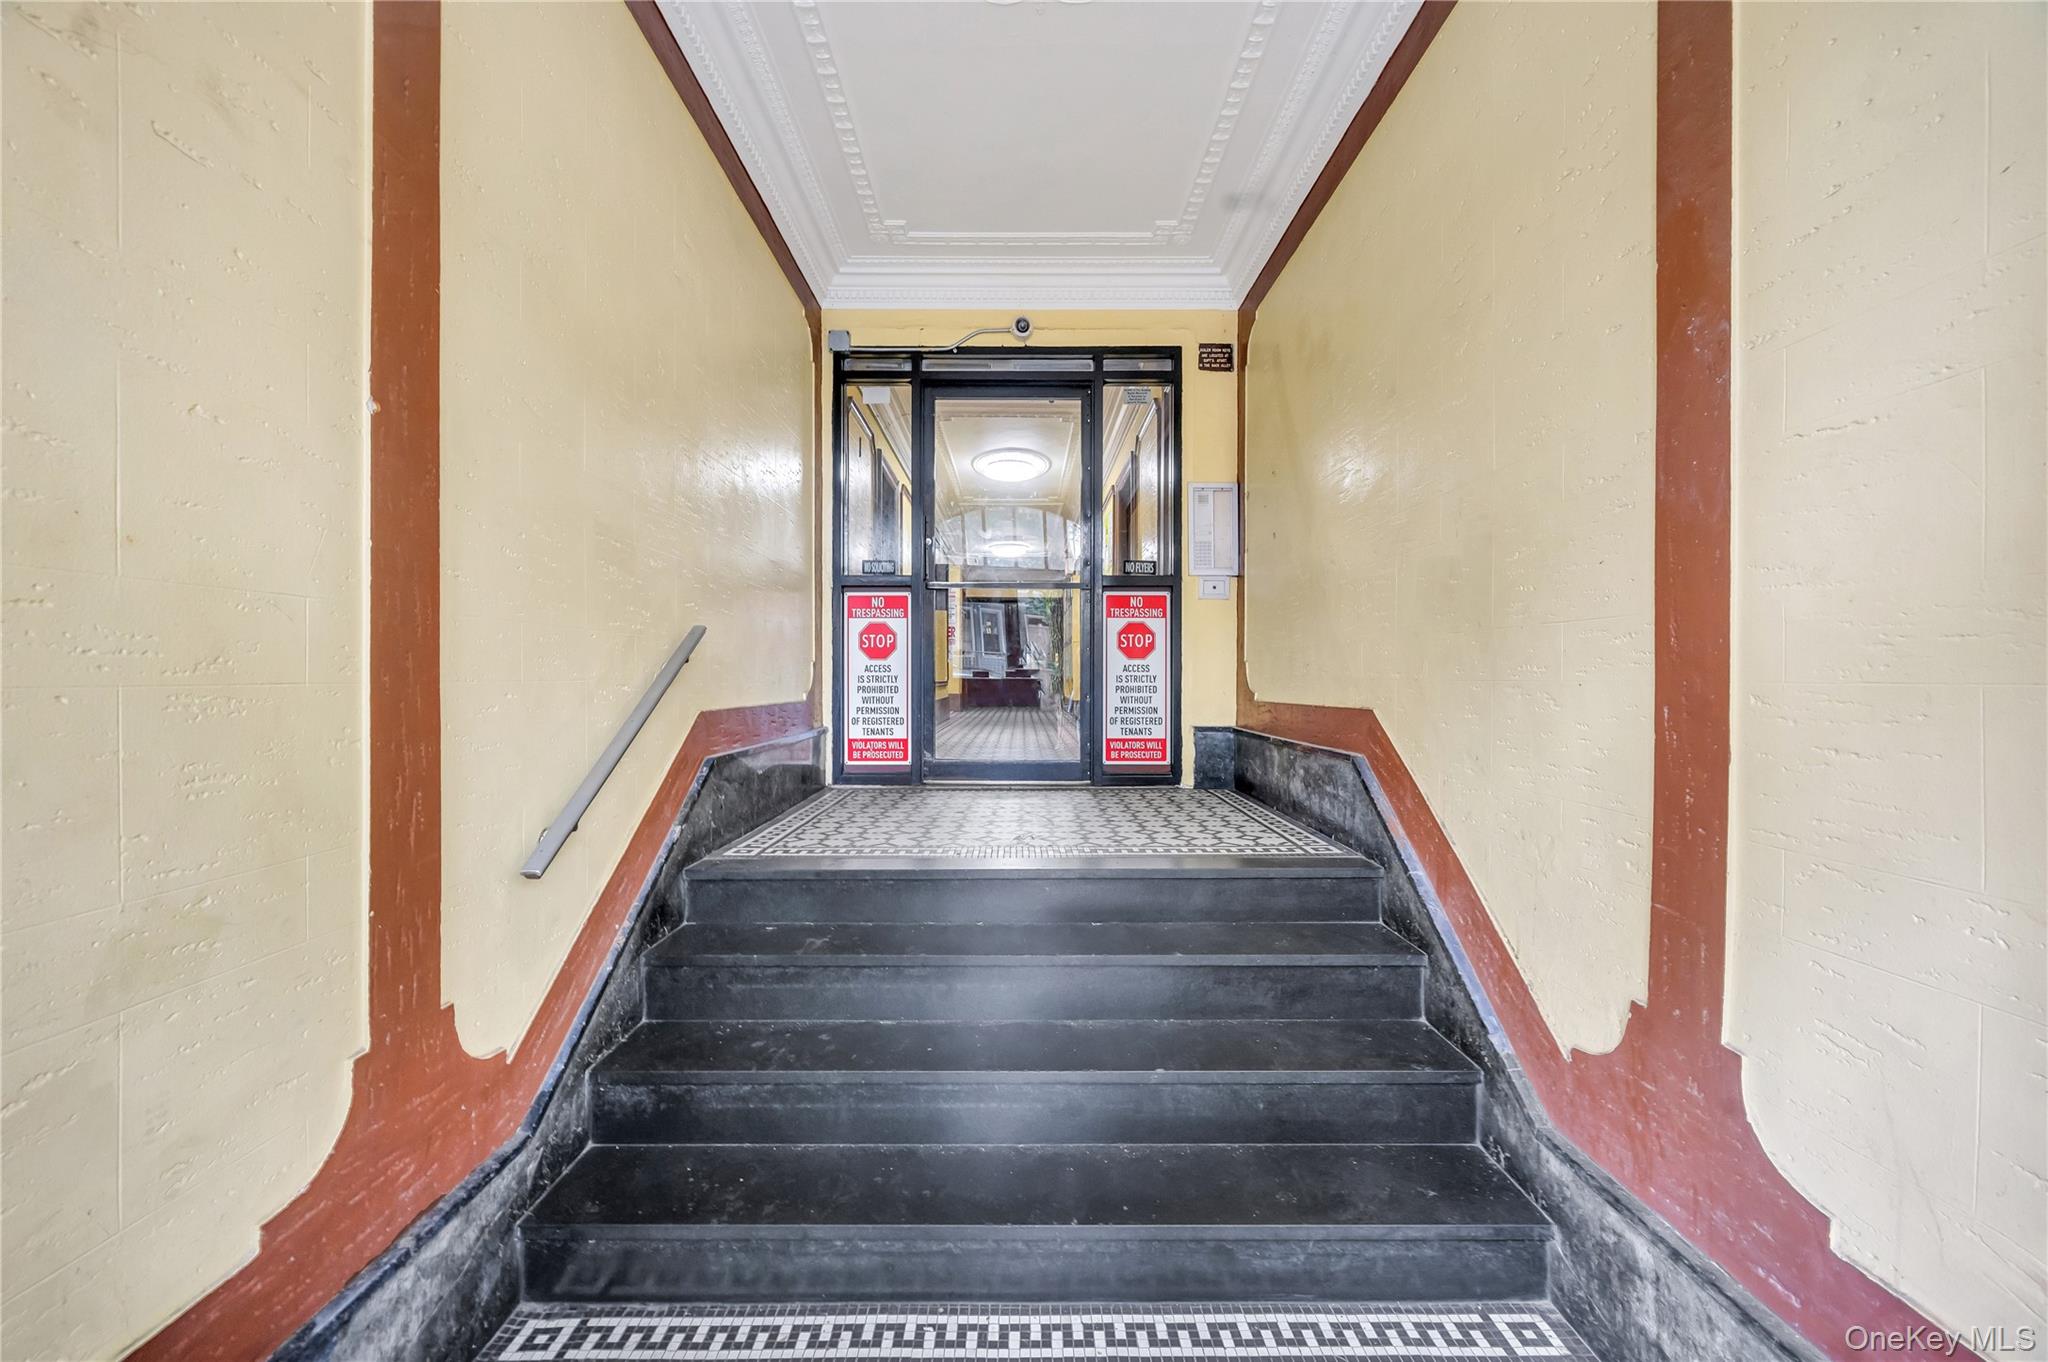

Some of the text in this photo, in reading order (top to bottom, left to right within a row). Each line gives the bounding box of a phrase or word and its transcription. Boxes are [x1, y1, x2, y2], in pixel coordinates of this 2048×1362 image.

[1125, 561, 1155, 574] NO FLYERS
[871, 596, 885, 608] NO
[1129, 596, 1143, 608] NO
[852, 608, 905, 618] TRESPASSING
[1110, 608, 1163, 618] TRESPASSING
[862, 634, 894, 648] STOP
[1120, 634, 1152, 648] STOP
[864, 664, 892, 673] ACCESS
[1122, 664, 1150, 673] ACCESS
[857, 675, 899, 684] IS STRICTLY
[1115, 675, 1157, 684] IS STRICTLY
[857, 685, 899, 694] PROHIBITED
[1115, 685, 1157, 694] PROHIBITED
[861, 696, 894, 705] WITHOUT
[1119, 696, 1152, 705] WITHOUT
[856, 706, 900, 715] PERMISSION
[1114, 706, 1158, 715] PERMISSION
[851, 717, 905, 726] OF REGISTERED
[1109, 717, 1163, 726] OF REGISTERED
[862, 727, 894, 736] TENANTS
[1120, 727, 1152, 736] TENANTS
[851, 741, 905, 750] VIOLATORS WILL
[1109, 741, 1163, 750] VIOLATORS WILL
[852, 750, 904, 759] BE PROSECUTED
[1110, 750, 1162, 759] BE PROSECUTED
